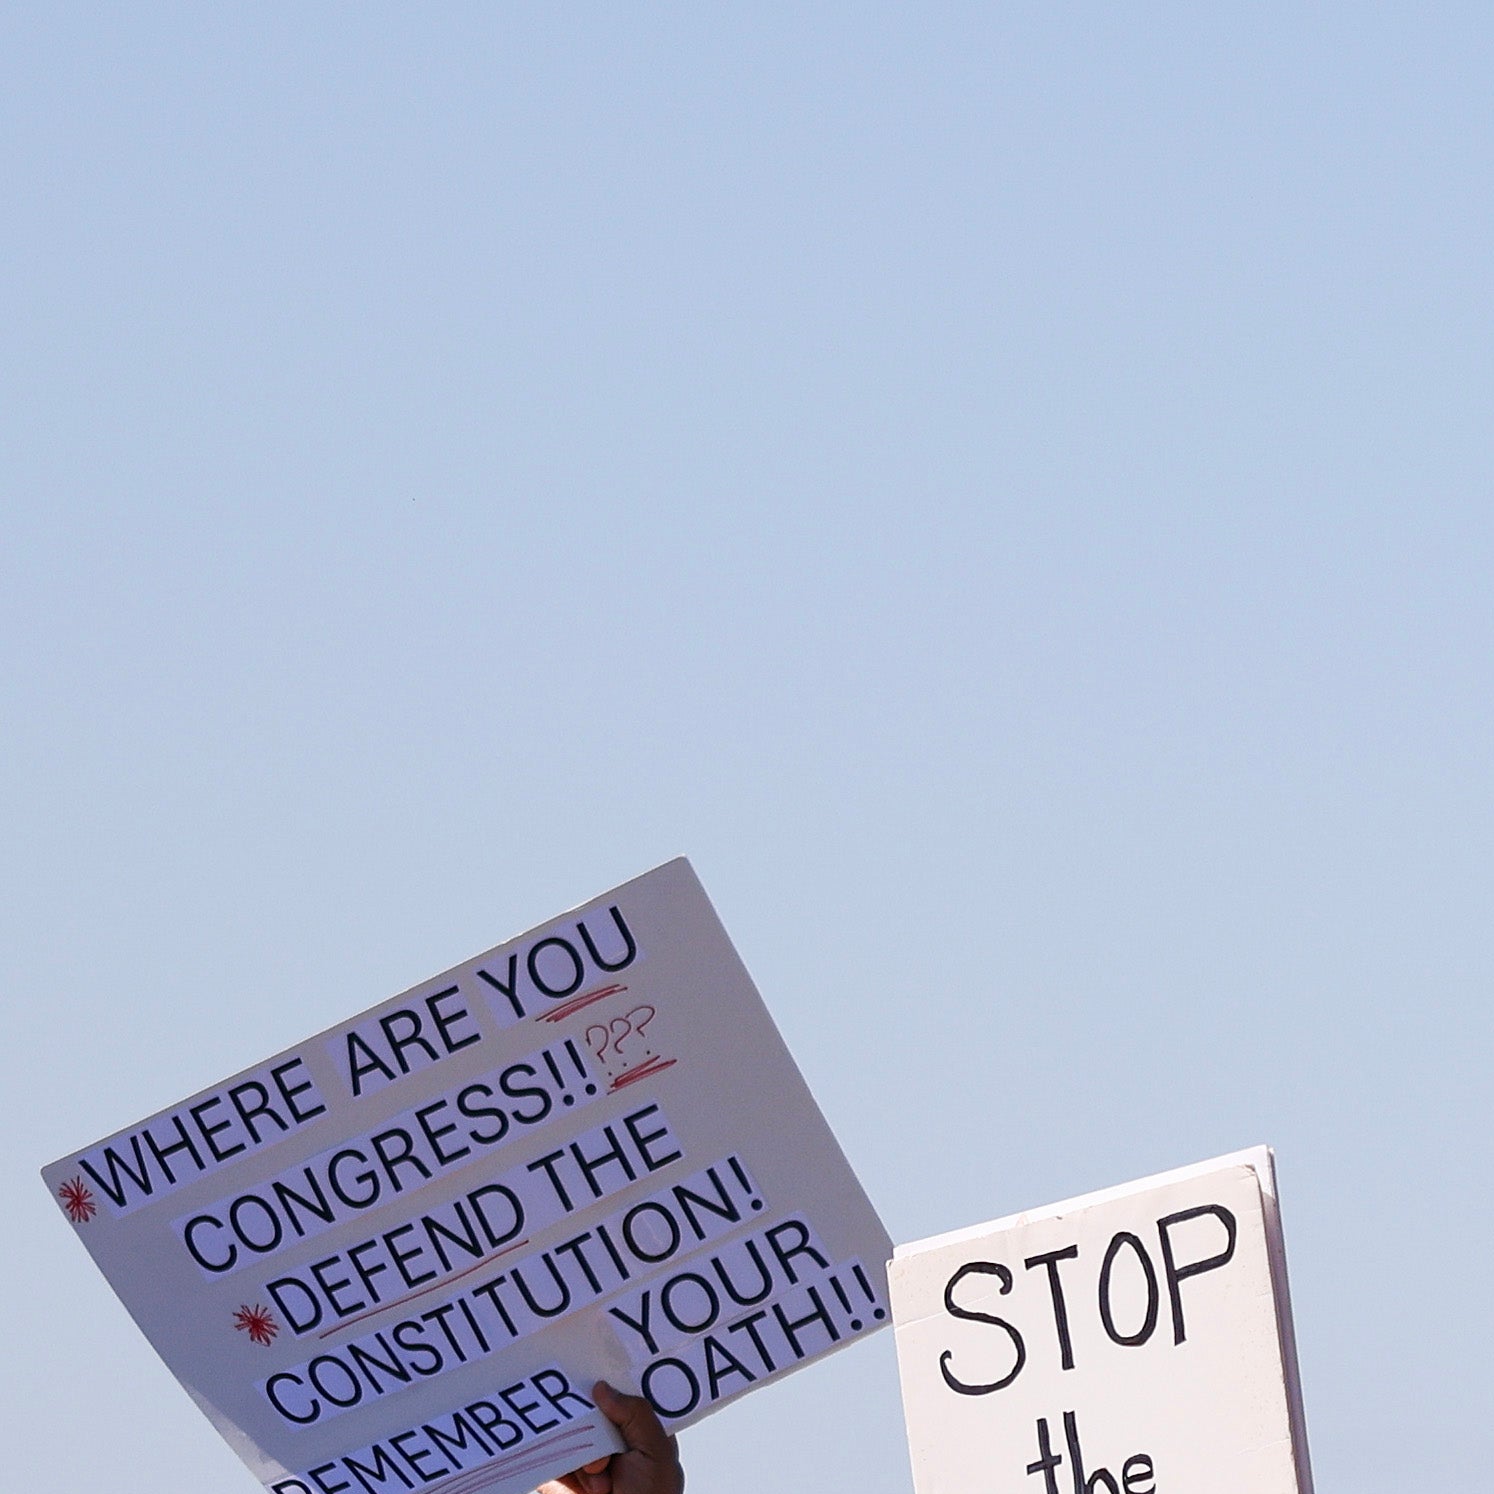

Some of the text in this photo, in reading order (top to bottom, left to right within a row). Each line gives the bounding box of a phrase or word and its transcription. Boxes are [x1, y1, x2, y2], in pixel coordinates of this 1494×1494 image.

[79, 906, 638, 1208] WHERE ARE YOU
[264, 1156, 763, 1424] CONSTITUTION!
[266, 1105, 683, 1335] DEFEND THE
[610, 1220, 830, 1353] YOUR
[940, 1204, 1236, 1395] STOP
[638, 1264, 886, 1418] OATH!!
